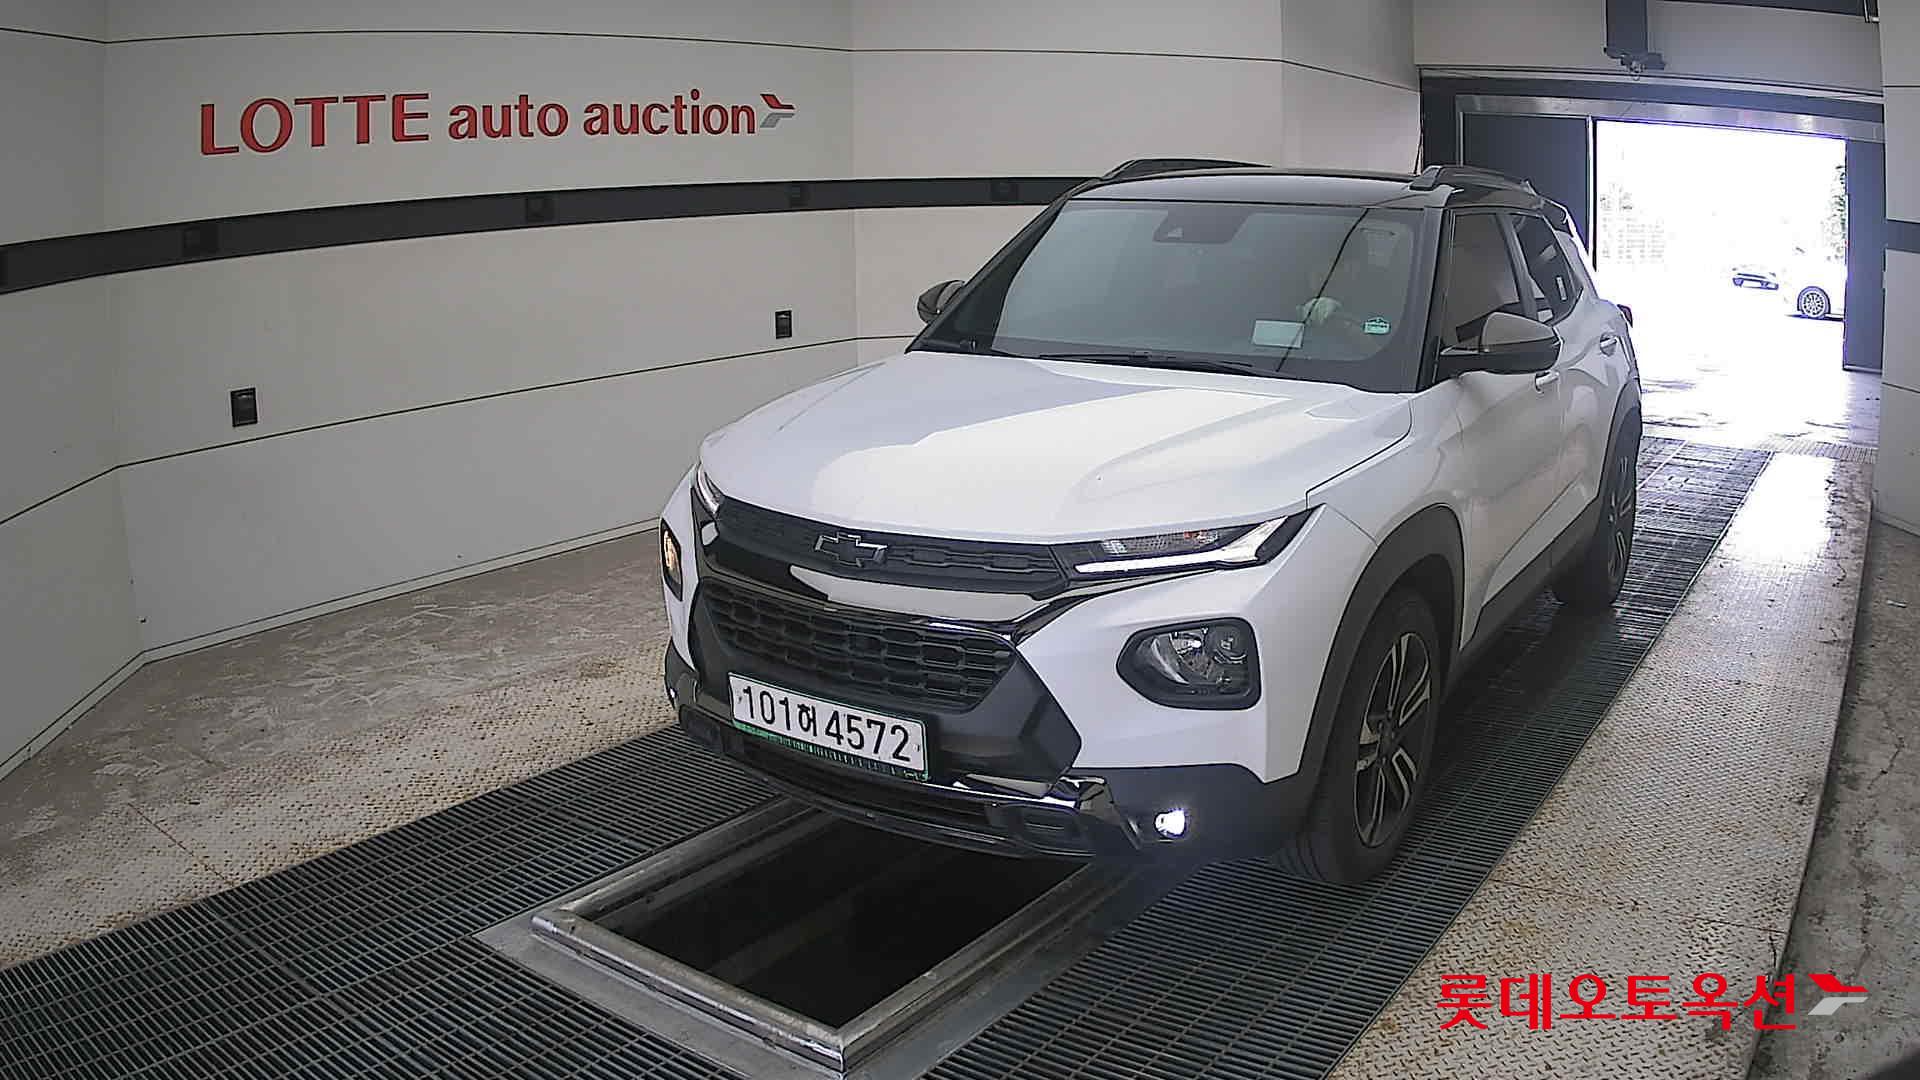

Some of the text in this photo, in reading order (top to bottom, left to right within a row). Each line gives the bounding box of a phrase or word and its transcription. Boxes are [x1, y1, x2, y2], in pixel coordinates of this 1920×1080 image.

[200, 88, 756, 156] LOTTE auto auction
